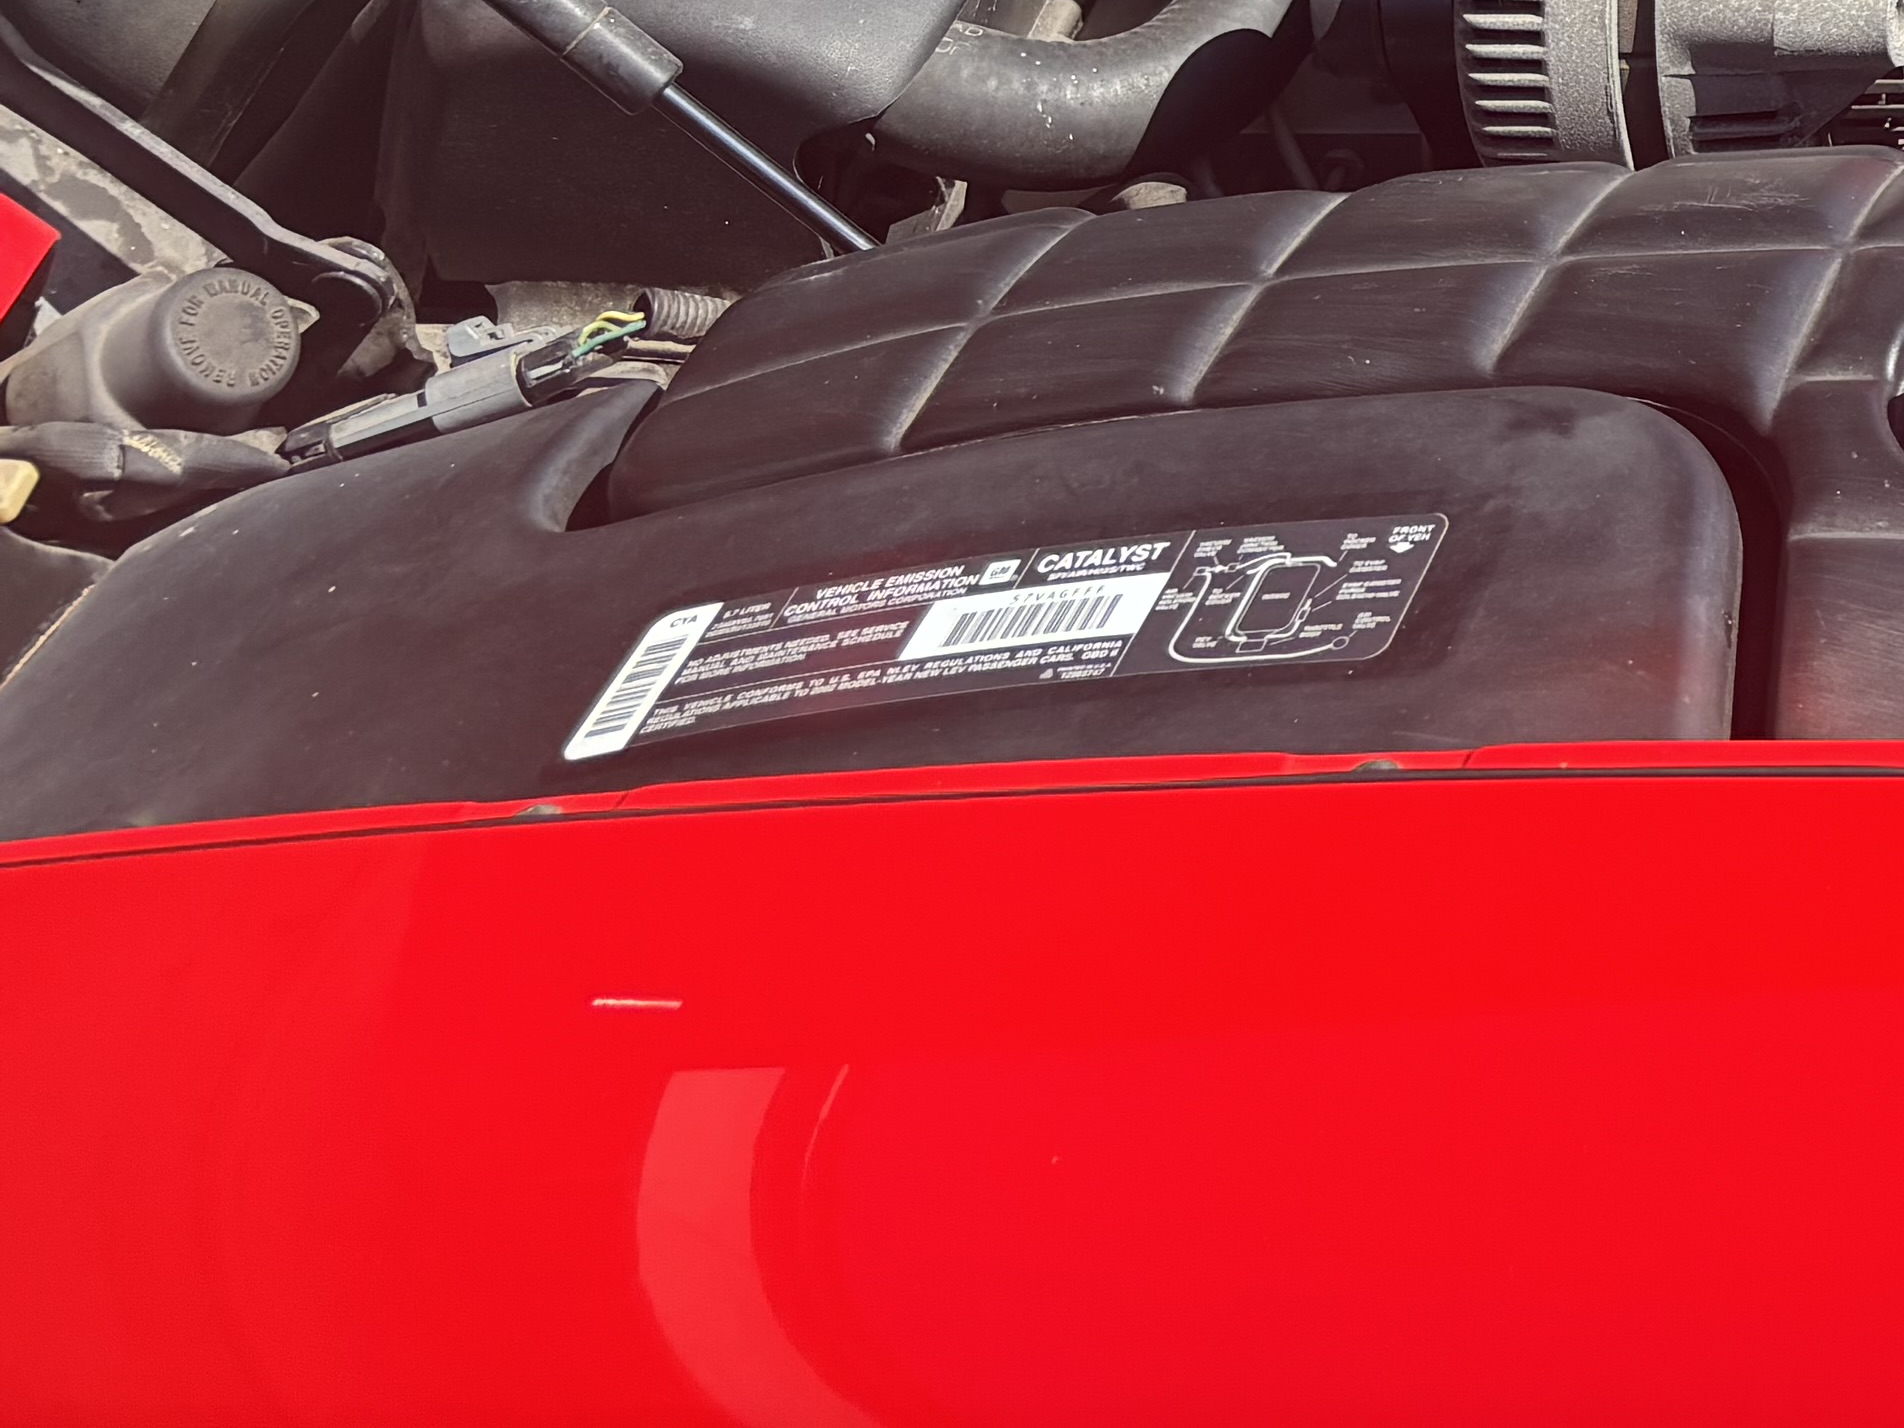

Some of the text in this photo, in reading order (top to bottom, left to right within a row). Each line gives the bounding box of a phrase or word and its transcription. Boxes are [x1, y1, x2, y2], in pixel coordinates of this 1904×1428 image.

[990, 565, 1011, 577] GM
[1036, 541, 1172, 574] CATALYST
[783, 574, 981, 617] CONTROL INFORMATION
[816, 565, 966, 601] VEHICLE EMISSION
[787, 588, 968, 624] GENERAL MOTORS CORPORATION
[924, 651, 1010, 671] REGULATIONS
[1014, 648, 1043, 659] AND
[1047, 639, 1123, 655] CALIFORNIA
